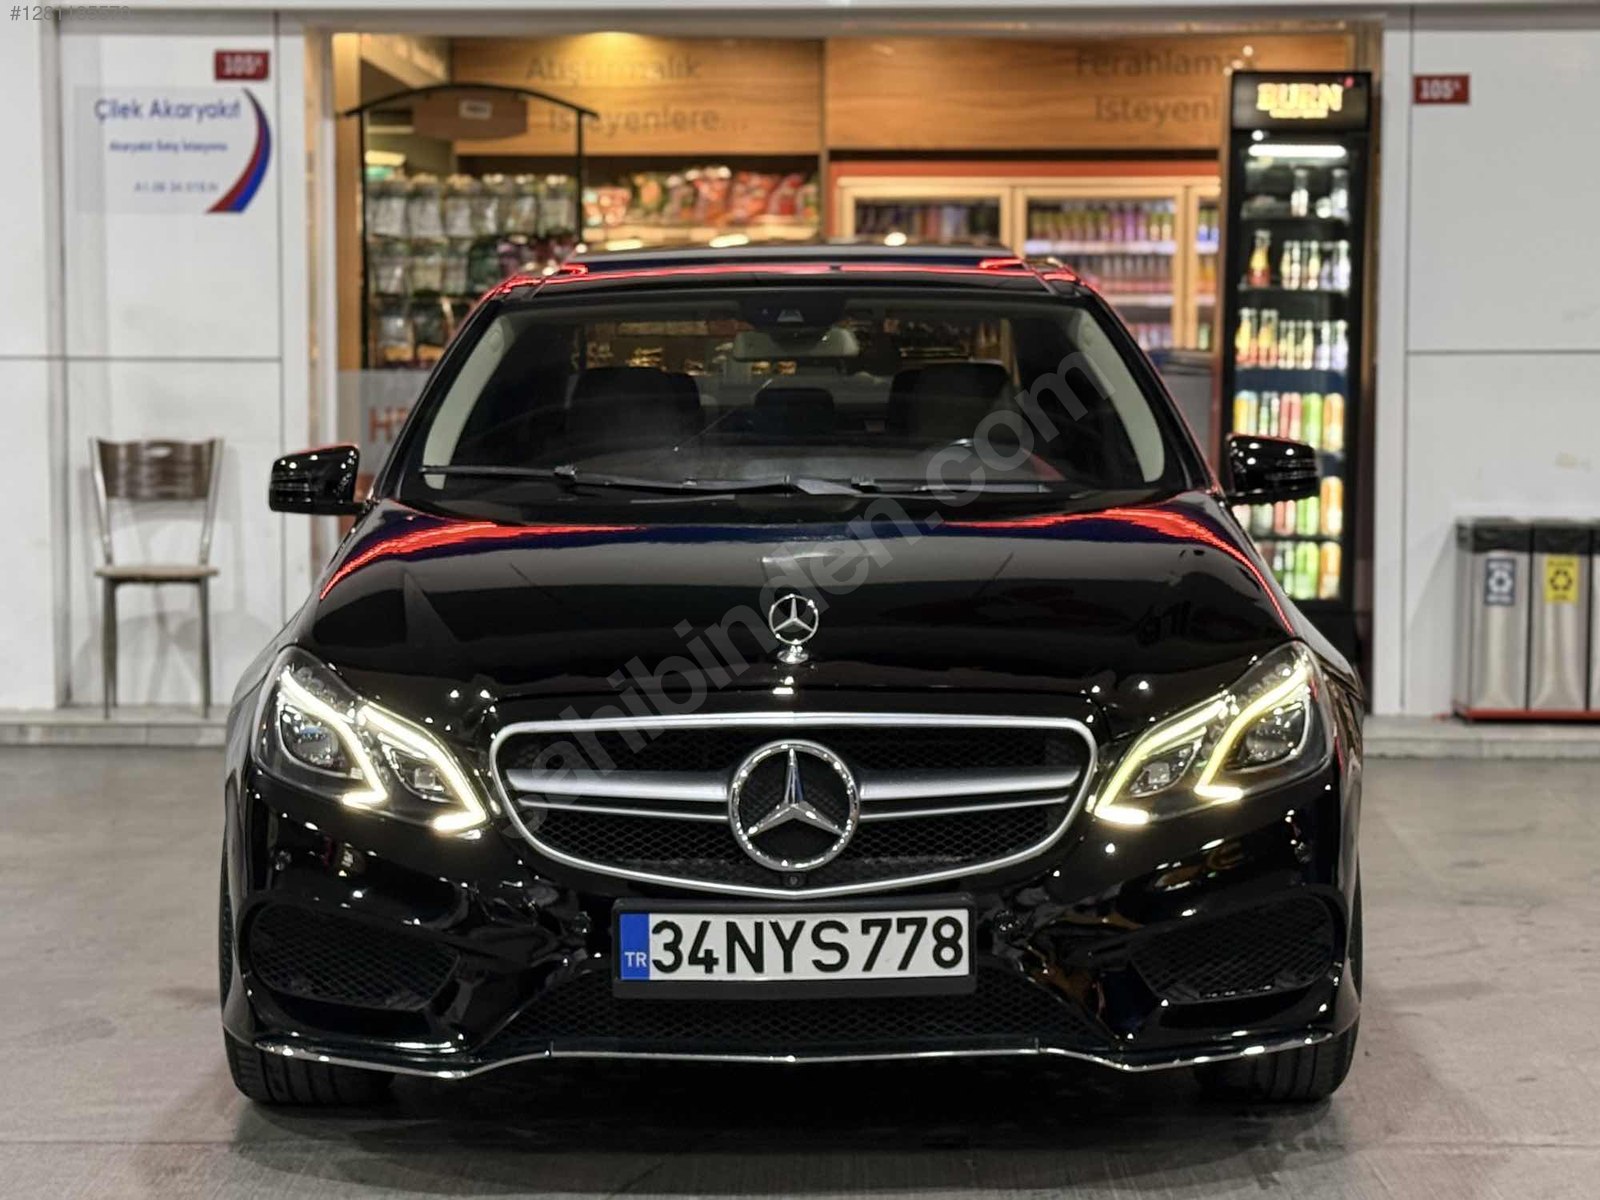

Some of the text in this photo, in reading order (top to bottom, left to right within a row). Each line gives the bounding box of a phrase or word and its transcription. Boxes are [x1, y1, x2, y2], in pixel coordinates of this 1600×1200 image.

[95, 98, 242, 125] Çilek Akaryakıt
[625, 916, 963, 974] TR 34NYS778
